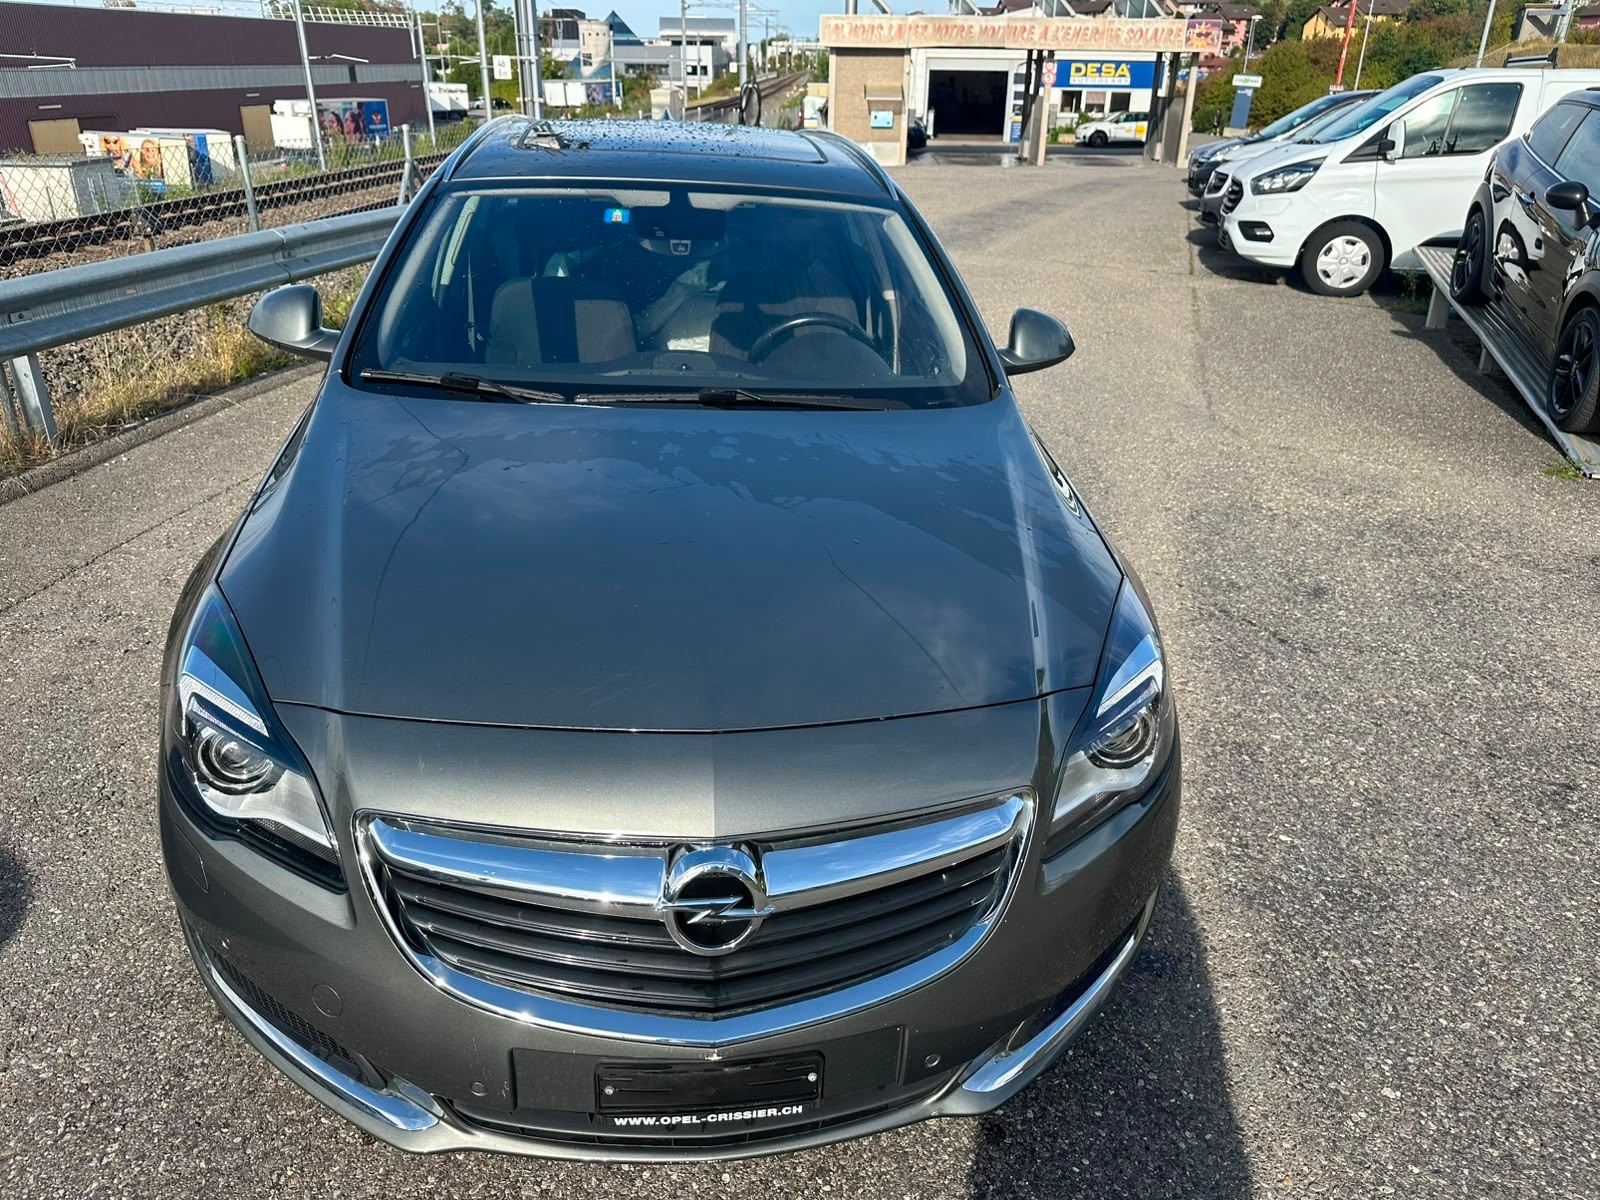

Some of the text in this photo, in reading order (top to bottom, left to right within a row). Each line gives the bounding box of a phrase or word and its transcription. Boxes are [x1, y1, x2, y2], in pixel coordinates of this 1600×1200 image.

[1124, 26, 1183, 43] SOLAIRE
[1070, 62, 1130, 77] DESA
[614, 1105, 803, 1126] WWW.OPEL-CRISSIER.CH
